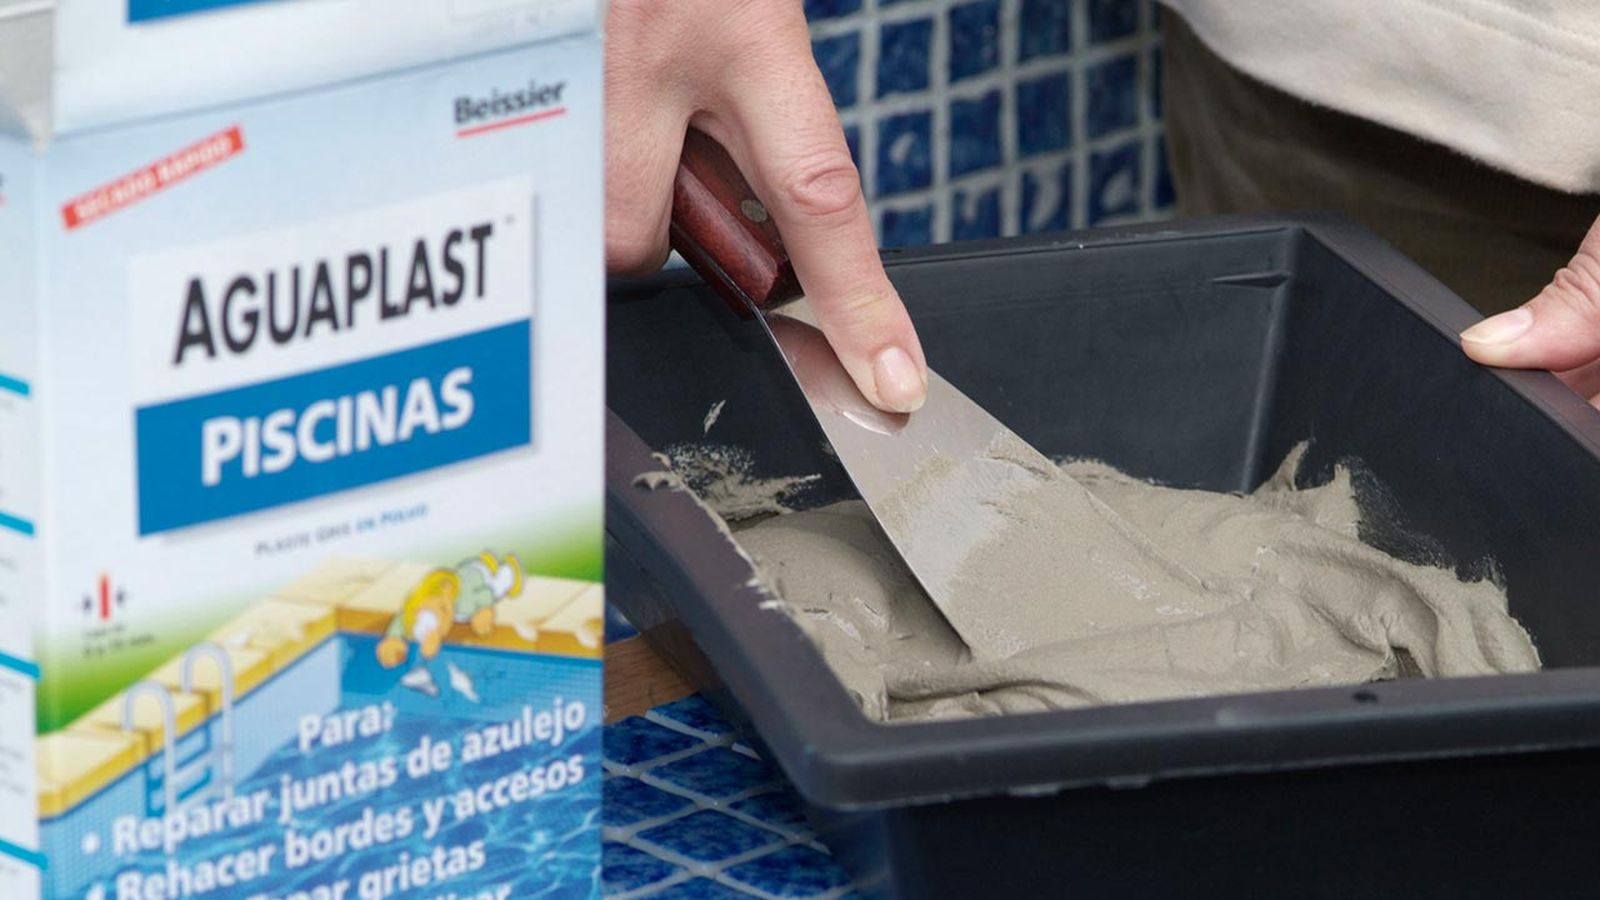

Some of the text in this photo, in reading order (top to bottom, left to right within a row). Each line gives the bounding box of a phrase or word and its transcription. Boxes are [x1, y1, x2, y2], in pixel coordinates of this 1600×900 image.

[454, 79, 566, 124] Beissier
[173, 223, 493, 366] AGUAPLAST
[201, 366, 475, 486] PISCINAS
[113, 698, 586, 855] Reparar juntas de azulejo
[298, 700, 394, 752] Para:
[116, 754, 585, 900] Rehacer bordes y accesos
[358, 840, 487, 900] grietas
